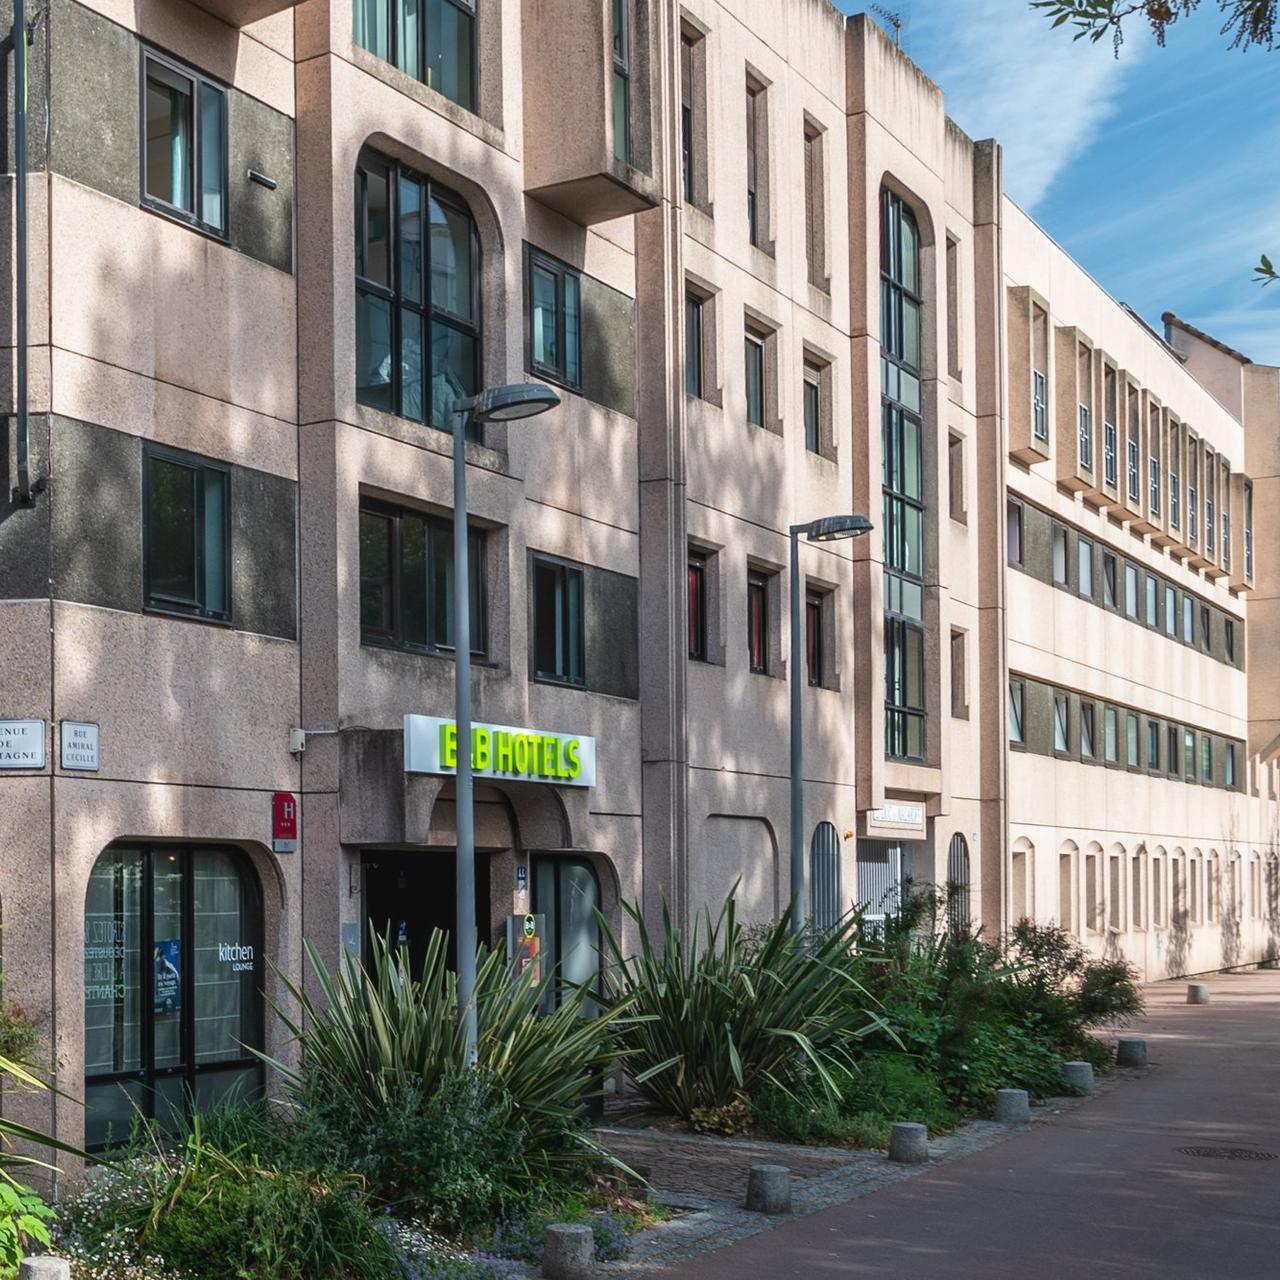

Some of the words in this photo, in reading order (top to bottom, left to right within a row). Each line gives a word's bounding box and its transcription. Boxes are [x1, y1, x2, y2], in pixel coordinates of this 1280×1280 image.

[73, 730, 88, 738] RUE
[67, 742, 94, 751] AMIRAL
[440, 724, 490, 770] BB
[493, 731, 581, 779] HOTELS
[284, 802, 294, 819] H
[218, 942, 254, 961] kitchen
[232, 962, 254, 971] LOUNGE
